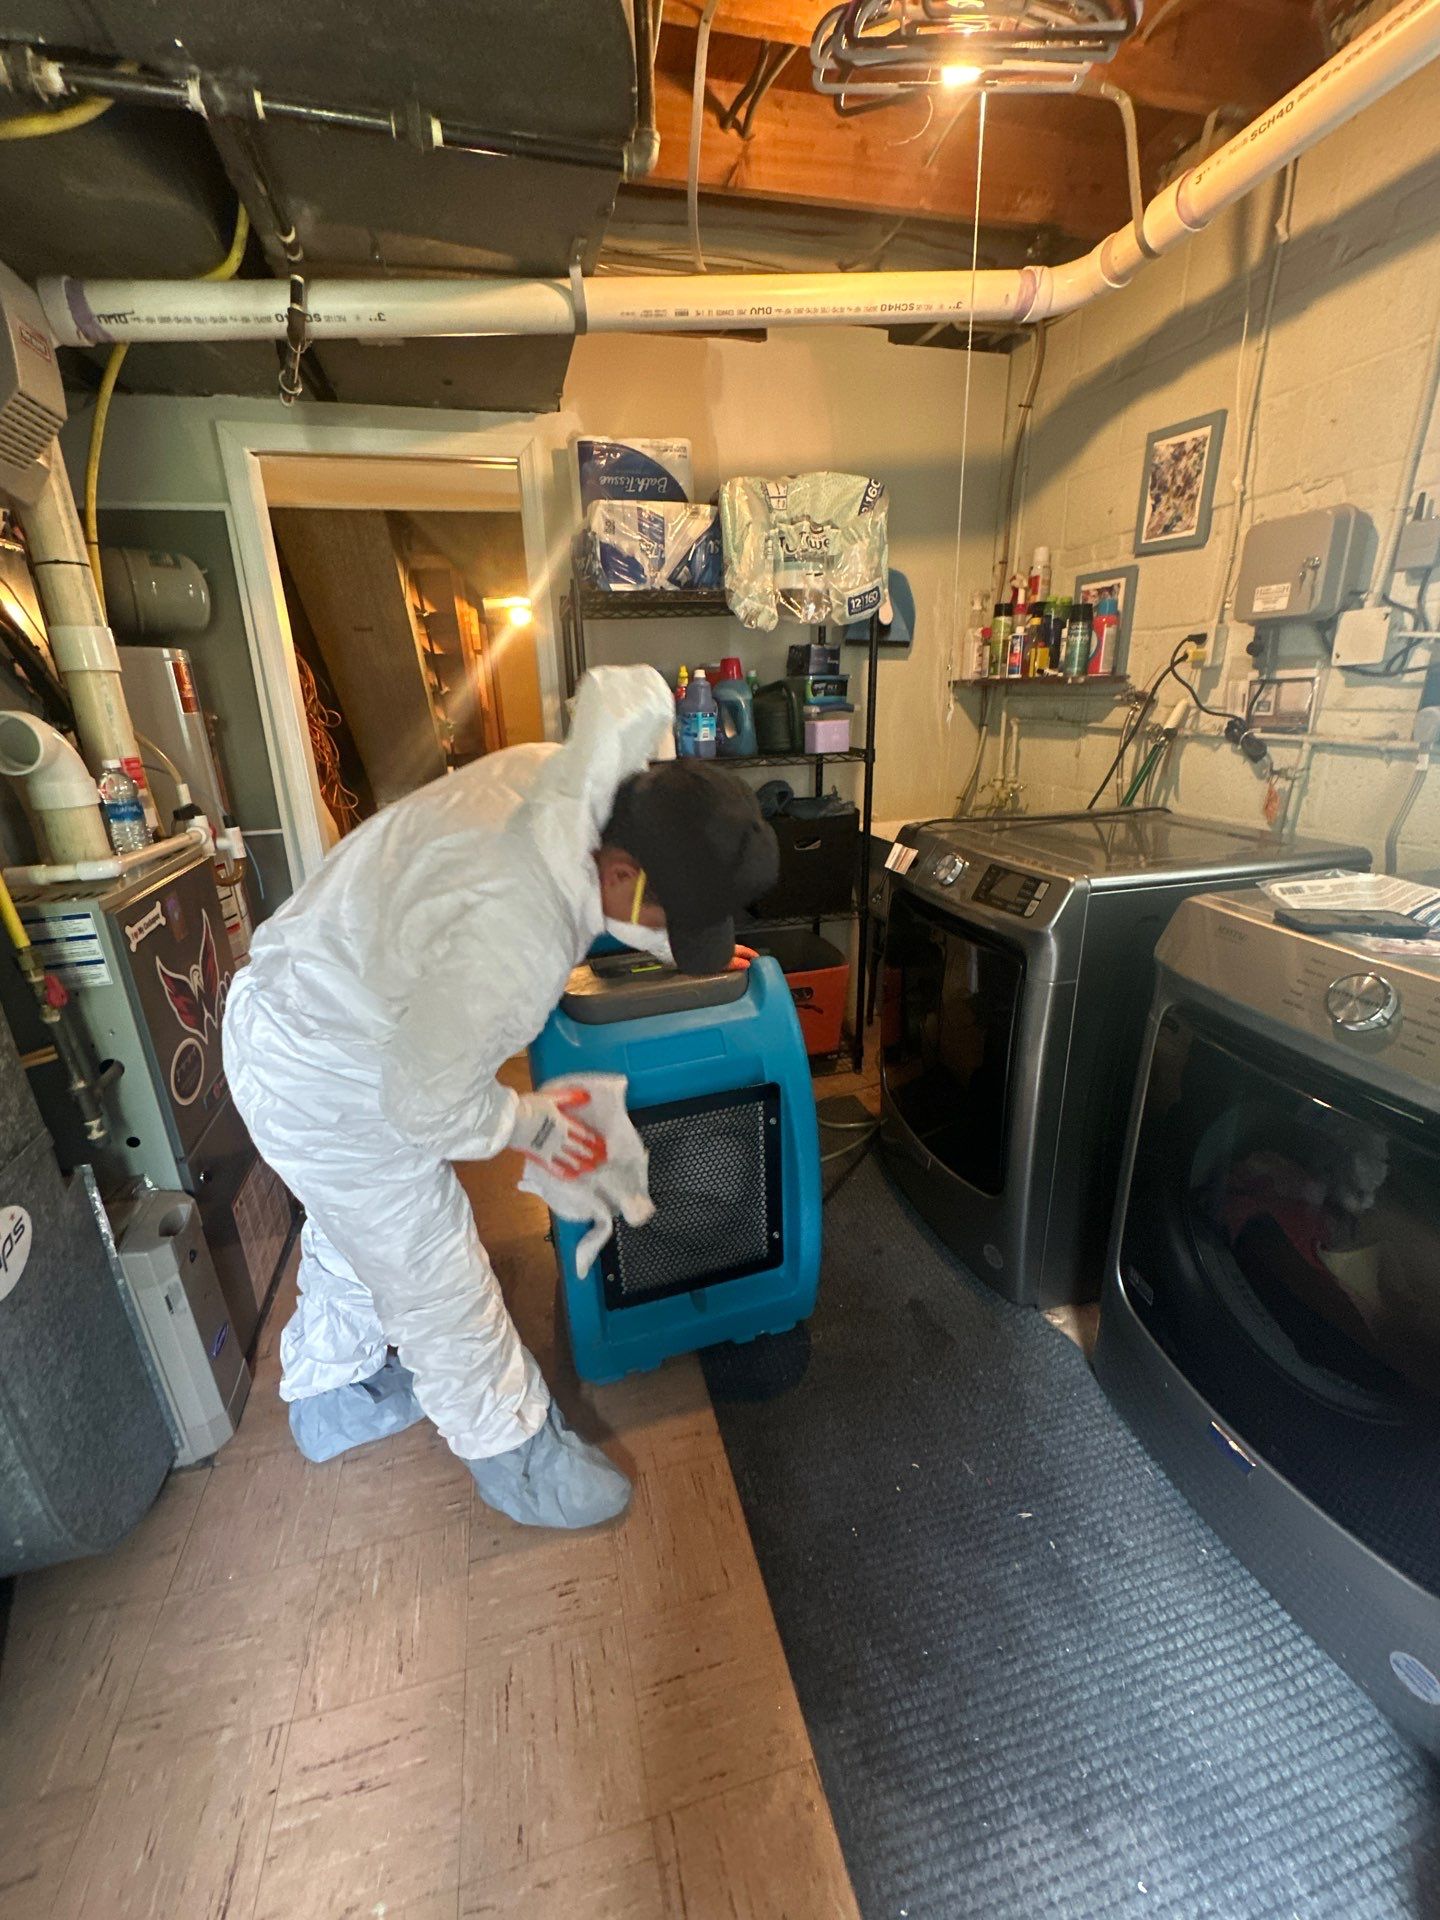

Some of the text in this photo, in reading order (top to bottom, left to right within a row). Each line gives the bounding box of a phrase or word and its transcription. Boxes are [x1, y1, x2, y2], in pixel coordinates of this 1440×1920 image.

[1250, 101, 1294, 141] SCH40
[750, 307, 772, 315] DWV
[880, 303, 915, 312] SCH40
[275, 313, 322, 323] SC0
[600, 475, 668, 493] Bath Tissue
[850, 598, 862, 608] 12
